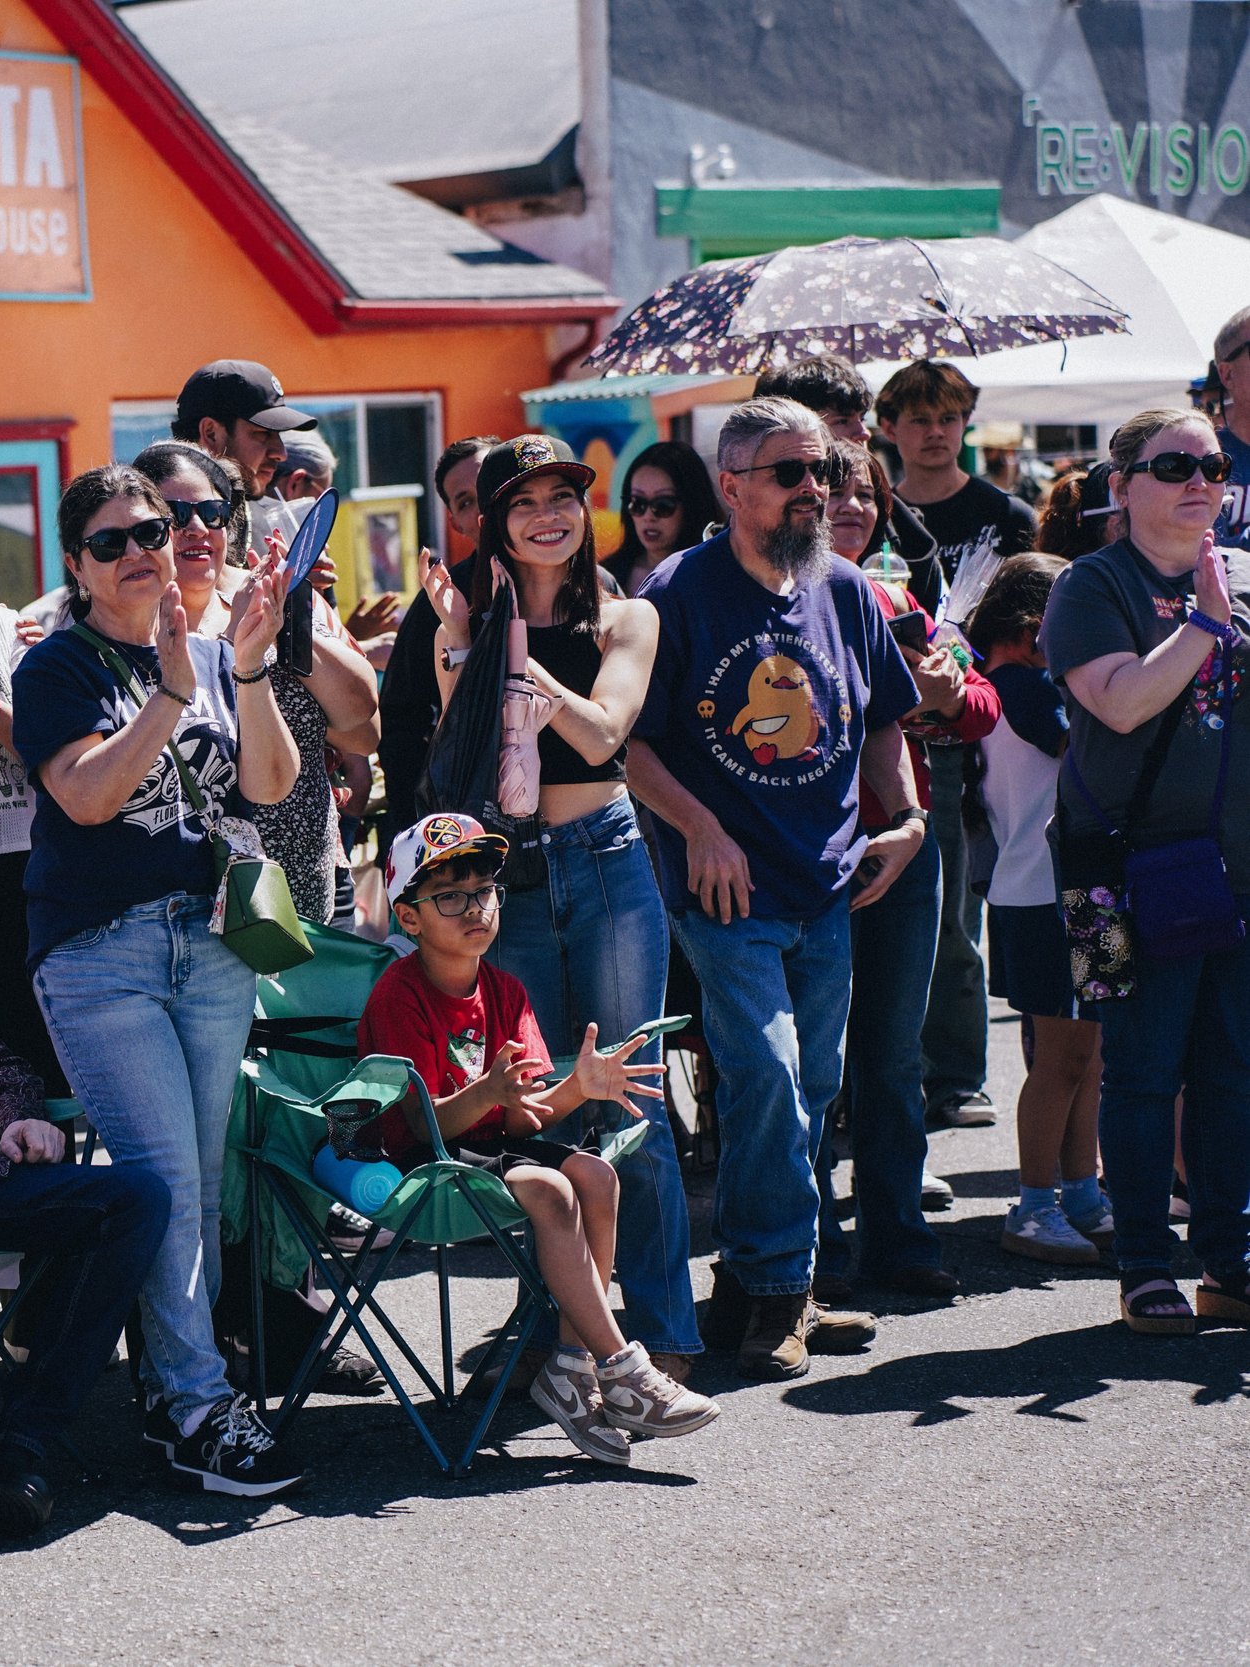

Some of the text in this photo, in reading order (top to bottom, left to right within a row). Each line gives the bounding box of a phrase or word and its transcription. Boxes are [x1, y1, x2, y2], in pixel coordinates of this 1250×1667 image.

[708, 657, 731, 687] HAD
[729, 637, 751, 658] MY
[754, 632, 817, 655] PATIENCE
[818, 651, 847, 698] TESTED
[704, 726, 848, 787] IT CAME BACK NEGATIVE
